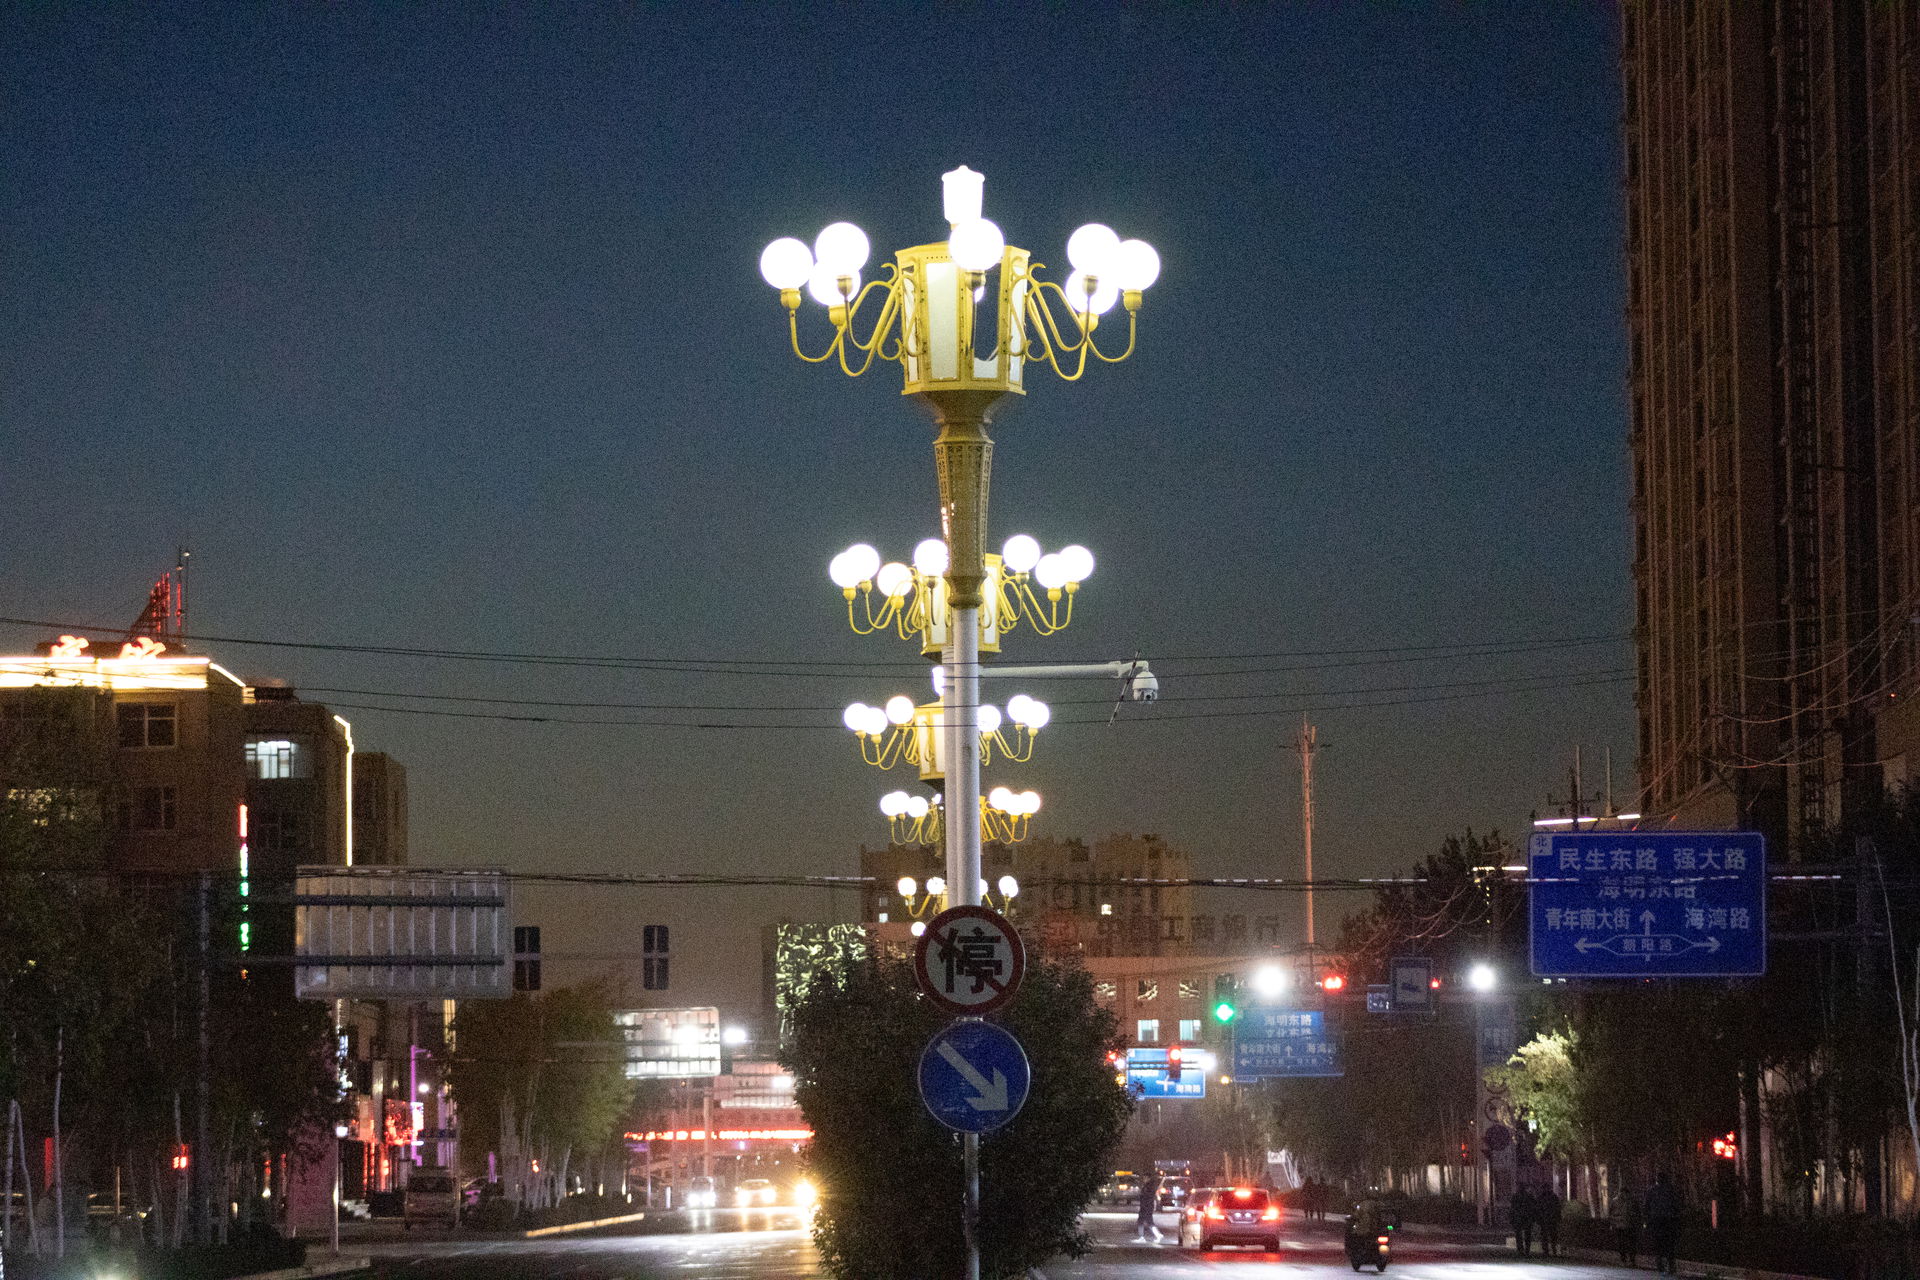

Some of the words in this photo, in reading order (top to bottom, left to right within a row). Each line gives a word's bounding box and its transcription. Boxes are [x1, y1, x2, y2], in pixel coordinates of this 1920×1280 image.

[1535, 837, 1547, 847] 北
[1559, 848, 1658, 870] 民生东路
[1673, 848, 1747, 870] 强大路
[1545, 908, 1630, 930] 青年南大街
[1685, 908, 1749, 930] 海湾路
[939, 927, 1002, 994] 停
